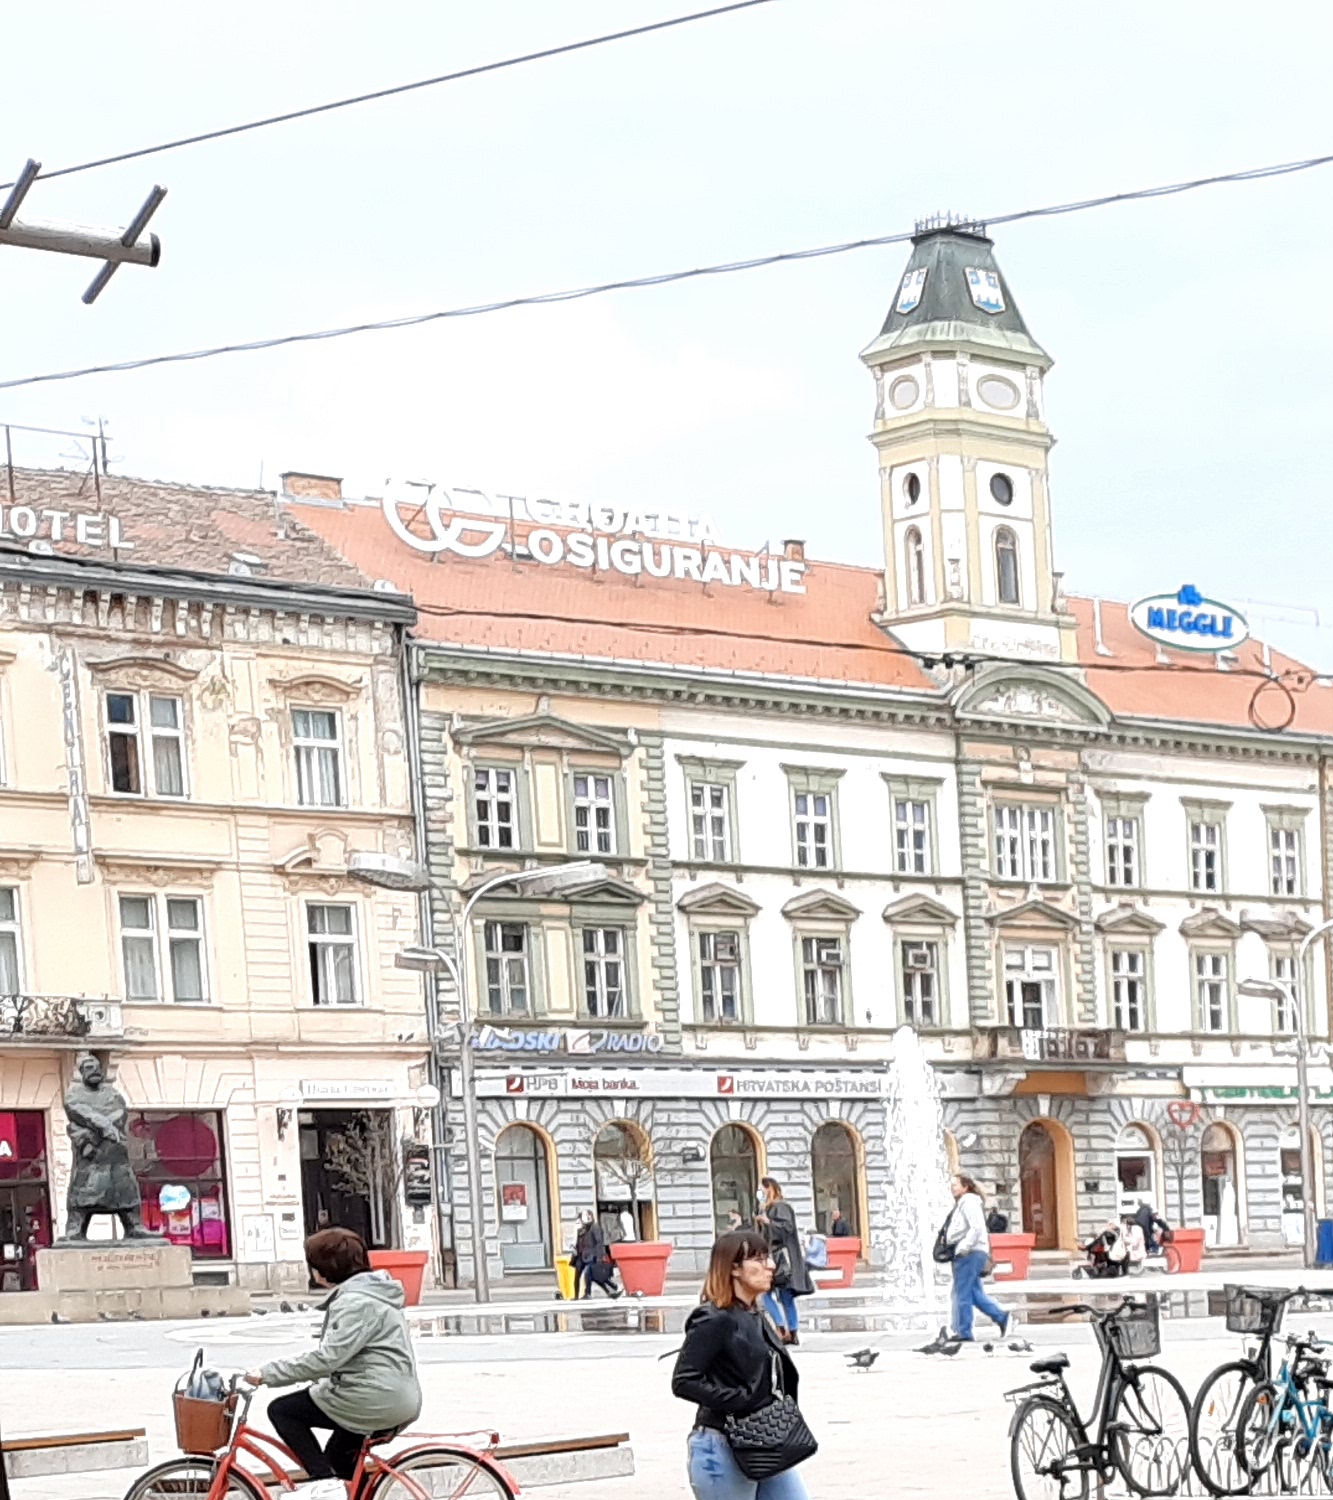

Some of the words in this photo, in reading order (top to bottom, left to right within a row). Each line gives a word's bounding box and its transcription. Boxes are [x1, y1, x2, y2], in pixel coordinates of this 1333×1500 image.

[527, 528, 808, 595] OSIGURANJE
[1147, 606, 1234, 639] MEGGLE
[736, 1079, 811, 1093] HRVATSKA
[815, 1076, 882, 1094] POŠTANS
